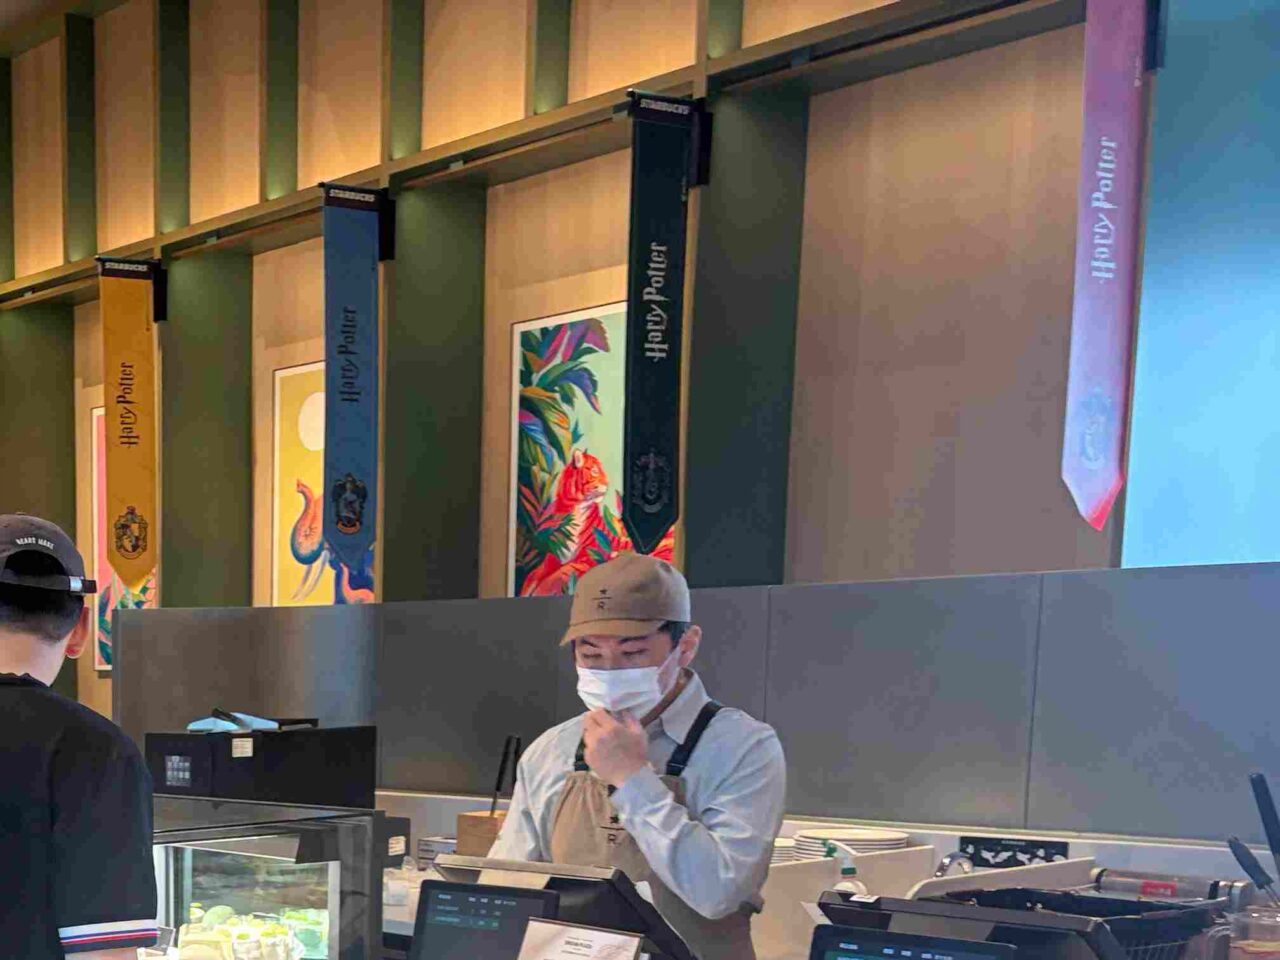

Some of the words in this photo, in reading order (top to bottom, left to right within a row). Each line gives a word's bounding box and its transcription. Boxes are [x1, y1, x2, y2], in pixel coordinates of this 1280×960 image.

[1091, 136, 1118, 209] Potter
[642, 242, 670, 301] Potter
[1090, 213, 1117, 284] Harry
[337, 306, 361, 355] Potter
[644, 304, 669, 361] Harry
[116, 362, 139, 404] Potter
[339, 358, 362, 404] Harry
[118, 406, 140, 448] Harry
